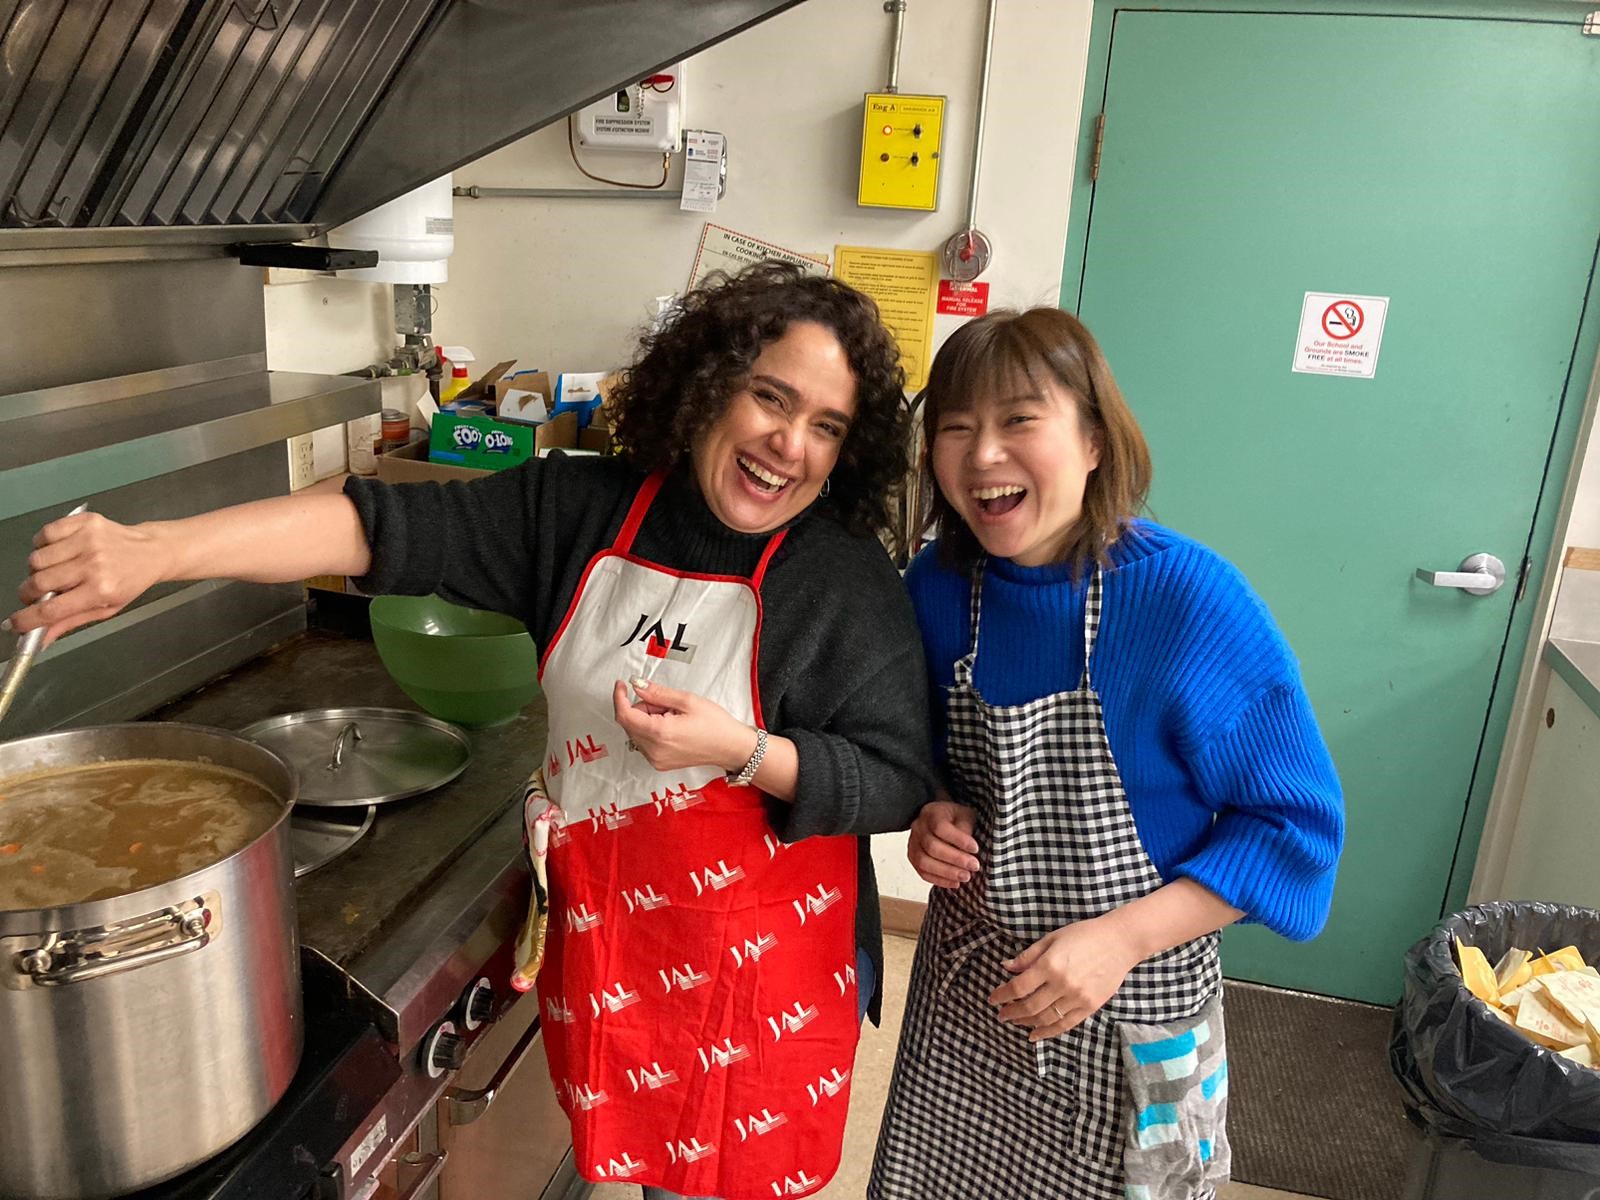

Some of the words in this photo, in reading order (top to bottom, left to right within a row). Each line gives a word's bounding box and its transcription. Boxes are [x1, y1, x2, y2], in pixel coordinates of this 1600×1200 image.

[731, 235, 746, 246] CASE
[747, 241, 755, 249] OF
[756, 244, 781, 257] KITCHEN
[782, 252, 814, 269] APPLIANCE
[736, 246, 763, 261] COOKING
[1304, 346, 1331, 355] Grounds
[1344, 350, 1370, 358] SMOKE
[453, 427, 482, 446] FOOT
[620, 613, 689, 652] JAL
[566, 734, 602, 767] JAL
[651, 783, 698, 816] JAL
[588, 803, 627, 834] JAL
[690, 859, 736, 896] JAL
[621, 884, 664, 914] JAL
[793, 883, 836, 927] JAL
[565, 903, 599, 934] JAL
[730, 932, 771, 969] JAL
[658, 963, 703, 994] JAL
[833, 963, 856, 997] JA
[589, 982, 633, 1019] JAL
[767, 1001, 812, 1042] JAL
[697, 1037, 742, 1073] JAL
[626, 1062, 671, 1094] JAL
[806, 1067, 847, 1107] JAL
[734, 1108, 780, 1142] JAL
[665, 1137, 709, 1165] JAL
